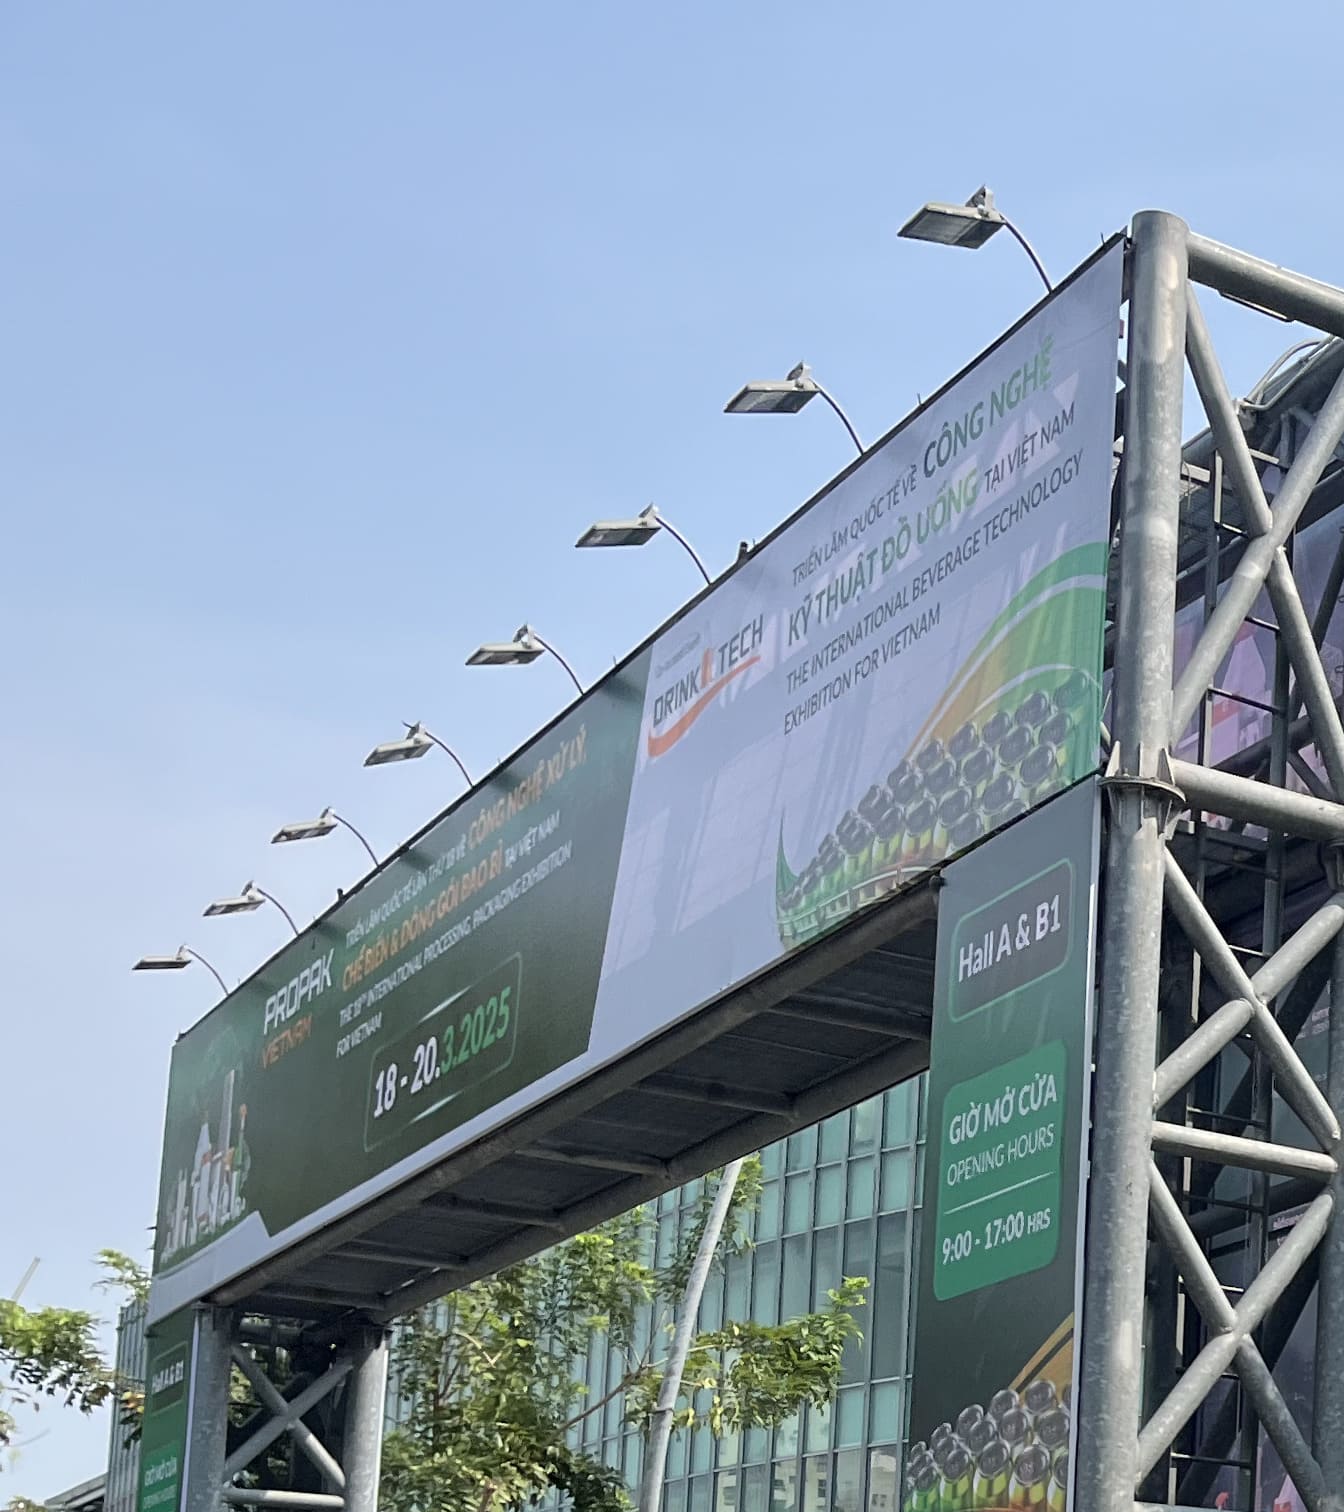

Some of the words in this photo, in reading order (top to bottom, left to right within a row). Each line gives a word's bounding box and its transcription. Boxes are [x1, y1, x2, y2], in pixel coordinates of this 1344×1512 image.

[923, 401, 985, 479] CÔNG
[989, 335, 1054, 430] NGHỆ
[881, 507, 911, 573] ĐỒ
[1040, 402, 1075, 456] NAM
[786, 657, 809, 694] THE
[810, 584, 909, 682] INTERNATIONAL
[912, 530, 980, 603] BEVERAGE
[983, 448, 1084, 546] TECHNOLOGY
[653, 666, 701, 728] DRINK
[718, 613, 764, 674] TECH
[784, 669, 853, 735] EXHIBITION
[855, 653, 879, 689] FOR
[881, 602, 941, 664] VIETNAM
[958, 929, 994, 982] Hall
[995, 925, 1012, 960] A
[1015, 913, 1032, 951] &
[1035, 894, 1062, 942] B1
[262, 1012, 313, 1070] VIETNAM
[264, 948, 334, 1036] PROPAK
[373, 1063, 398, 1118] 18
[411, 986, 511, 1094] 20.3.2025
[947, 1143, 1005, 1188] OPENING
[1007, 1123, 1055, 1164] HOURS
[949, 1101, 982, 1145] GIỜ
[983, 1083, 1015, 1128] MỞ
[1017, 1073, 1057, 1115] CỬA
[942, 1230, 972, 1266] 9:00
[984, 1211, 1025, 1250] 17:00
[1026, 1207, 1051, 1240] HRS
